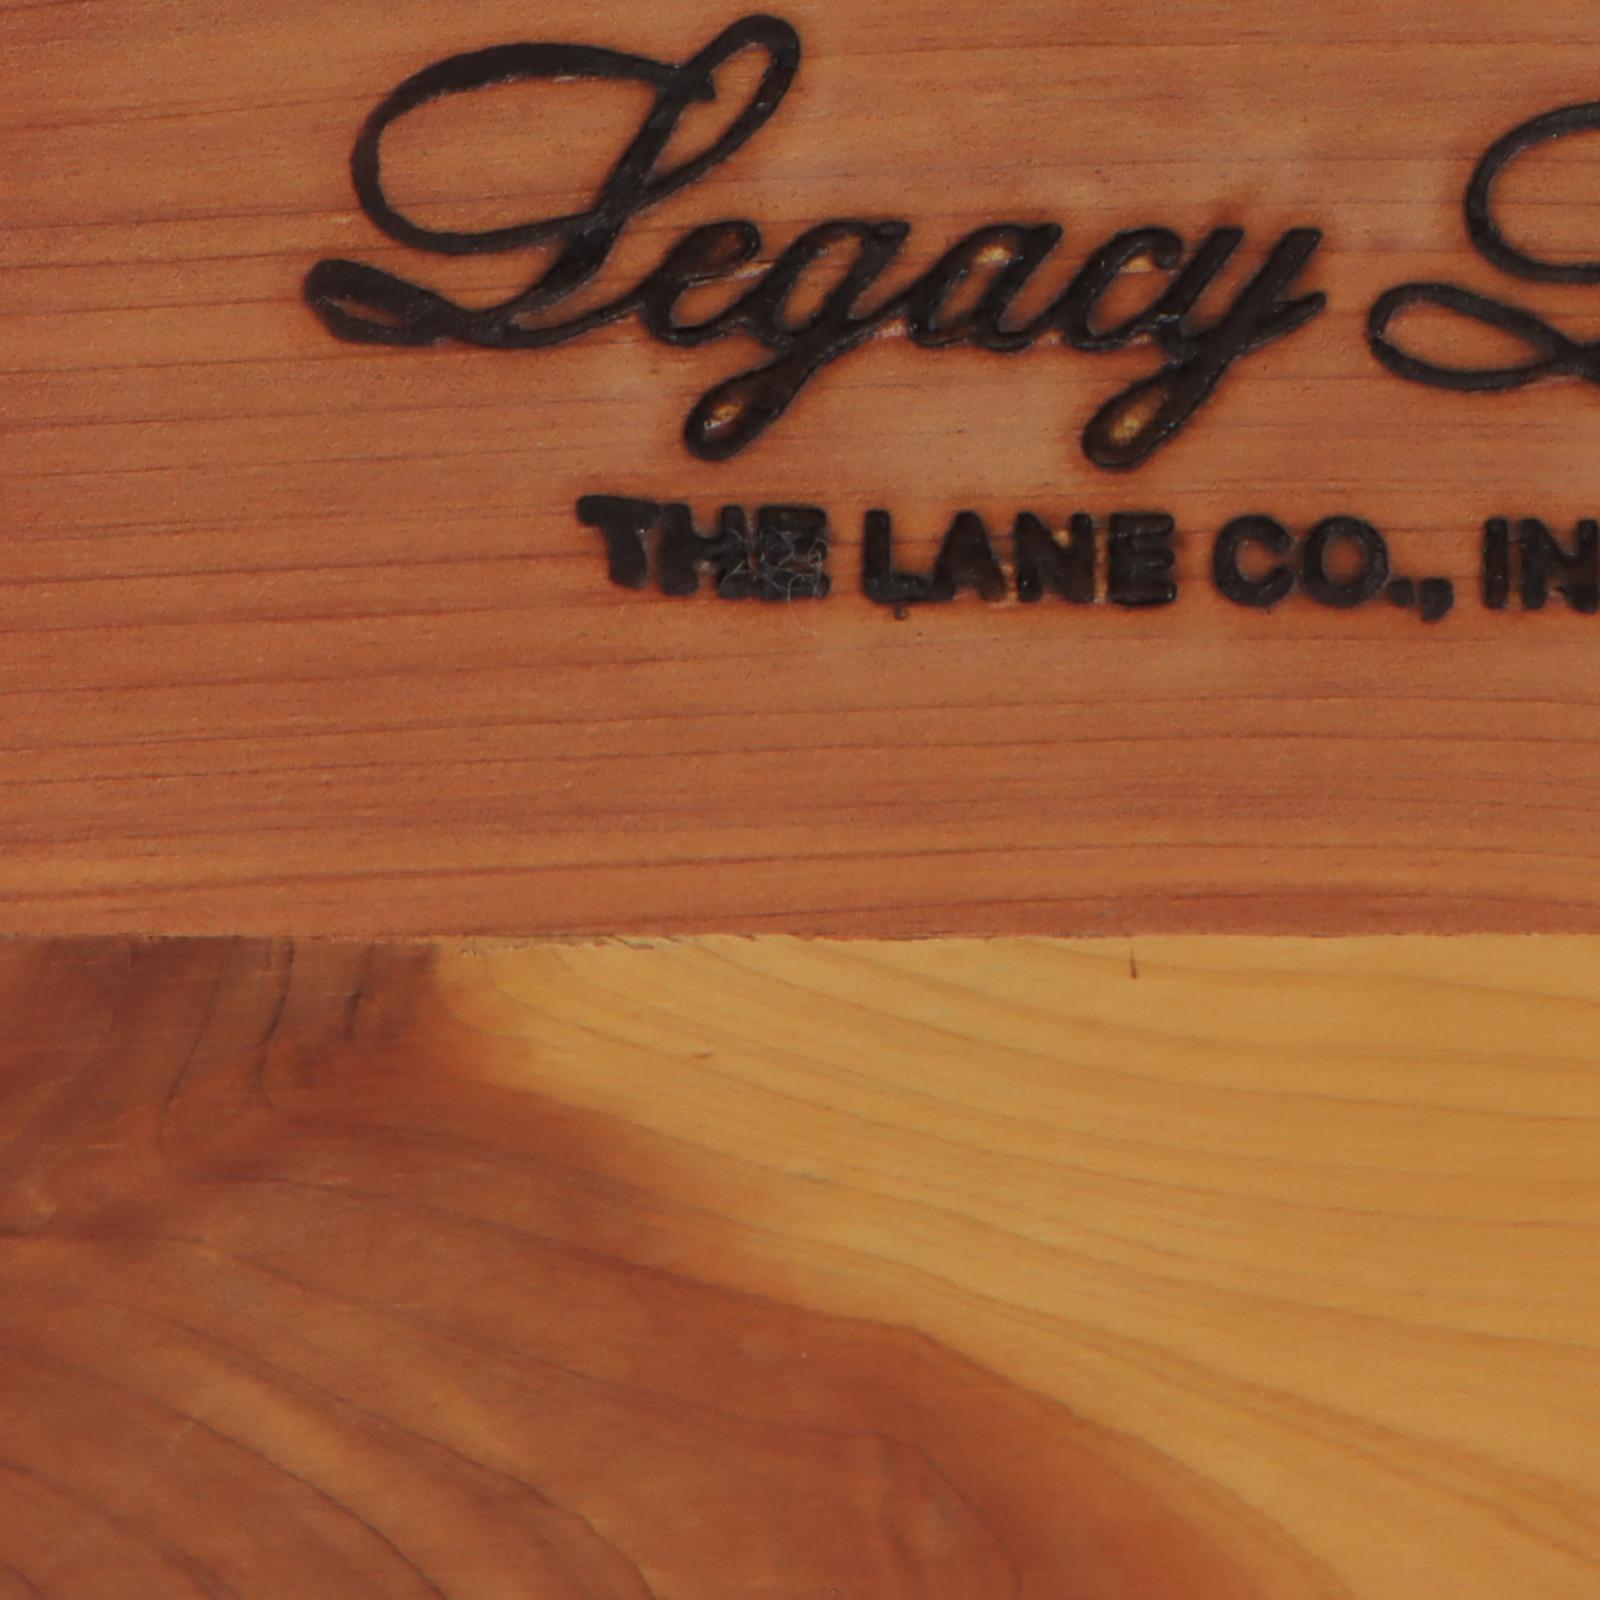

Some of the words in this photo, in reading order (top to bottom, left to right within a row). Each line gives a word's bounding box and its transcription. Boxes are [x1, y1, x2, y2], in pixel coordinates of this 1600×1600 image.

[304, 15, 1326, 472] Legacy
[577, 495, 832, 603] THE
[860, 508, 1183, 617] LANE
[1210, 513, 1454, 622] CO.,
